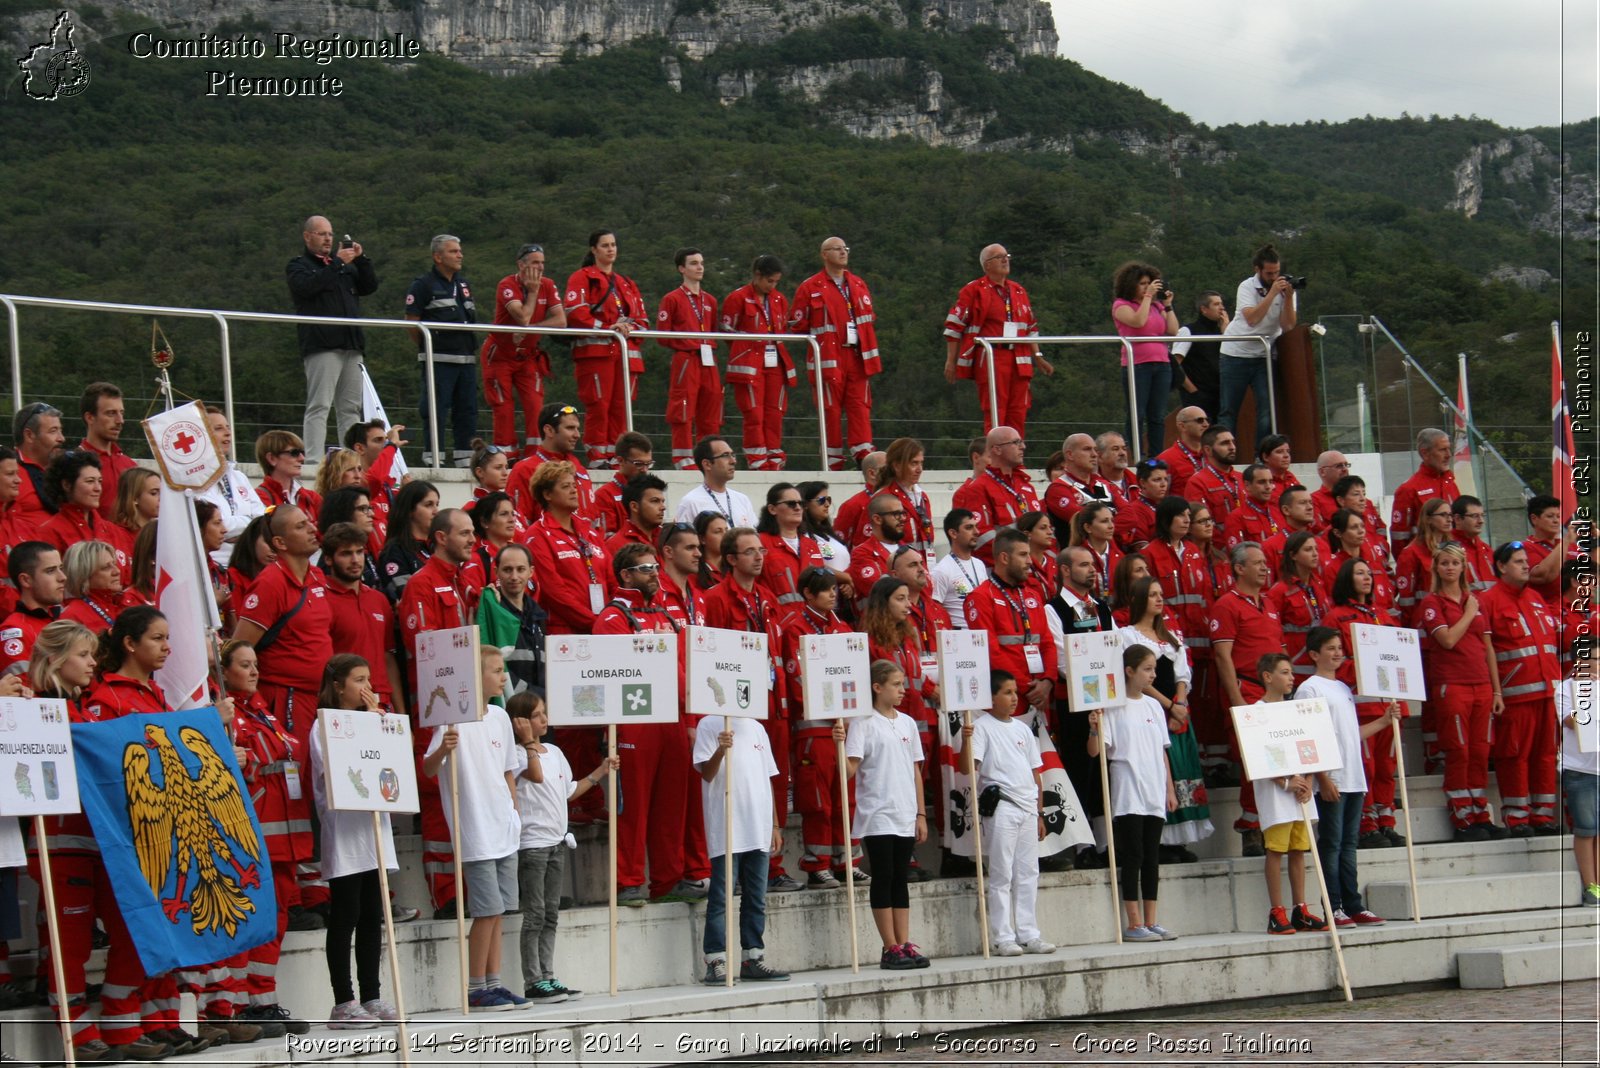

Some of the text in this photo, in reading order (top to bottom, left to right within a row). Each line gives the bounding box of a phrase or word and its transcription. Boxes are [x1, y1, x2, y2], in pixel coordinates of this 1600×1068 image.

[1379, 653, 1400, 661] UMBRIA
[715, 661, 742, 673] MARCHE
[955, 661, 977, 669] SARDEGNA
[1090, 662, 1105, 670] SICILIA
[435, 666, 455, 678] LIGURIA
[581, 669, 642, 678] LOMBARDIA
[824, 666, 851, 675] PIEMONTE
[1268, 728, 1306, 739] TOSCANA
[0, 743, 68, 755] RIULI-VENEZIA GIULIA
[360, 750, 381, 760] LAZIO
